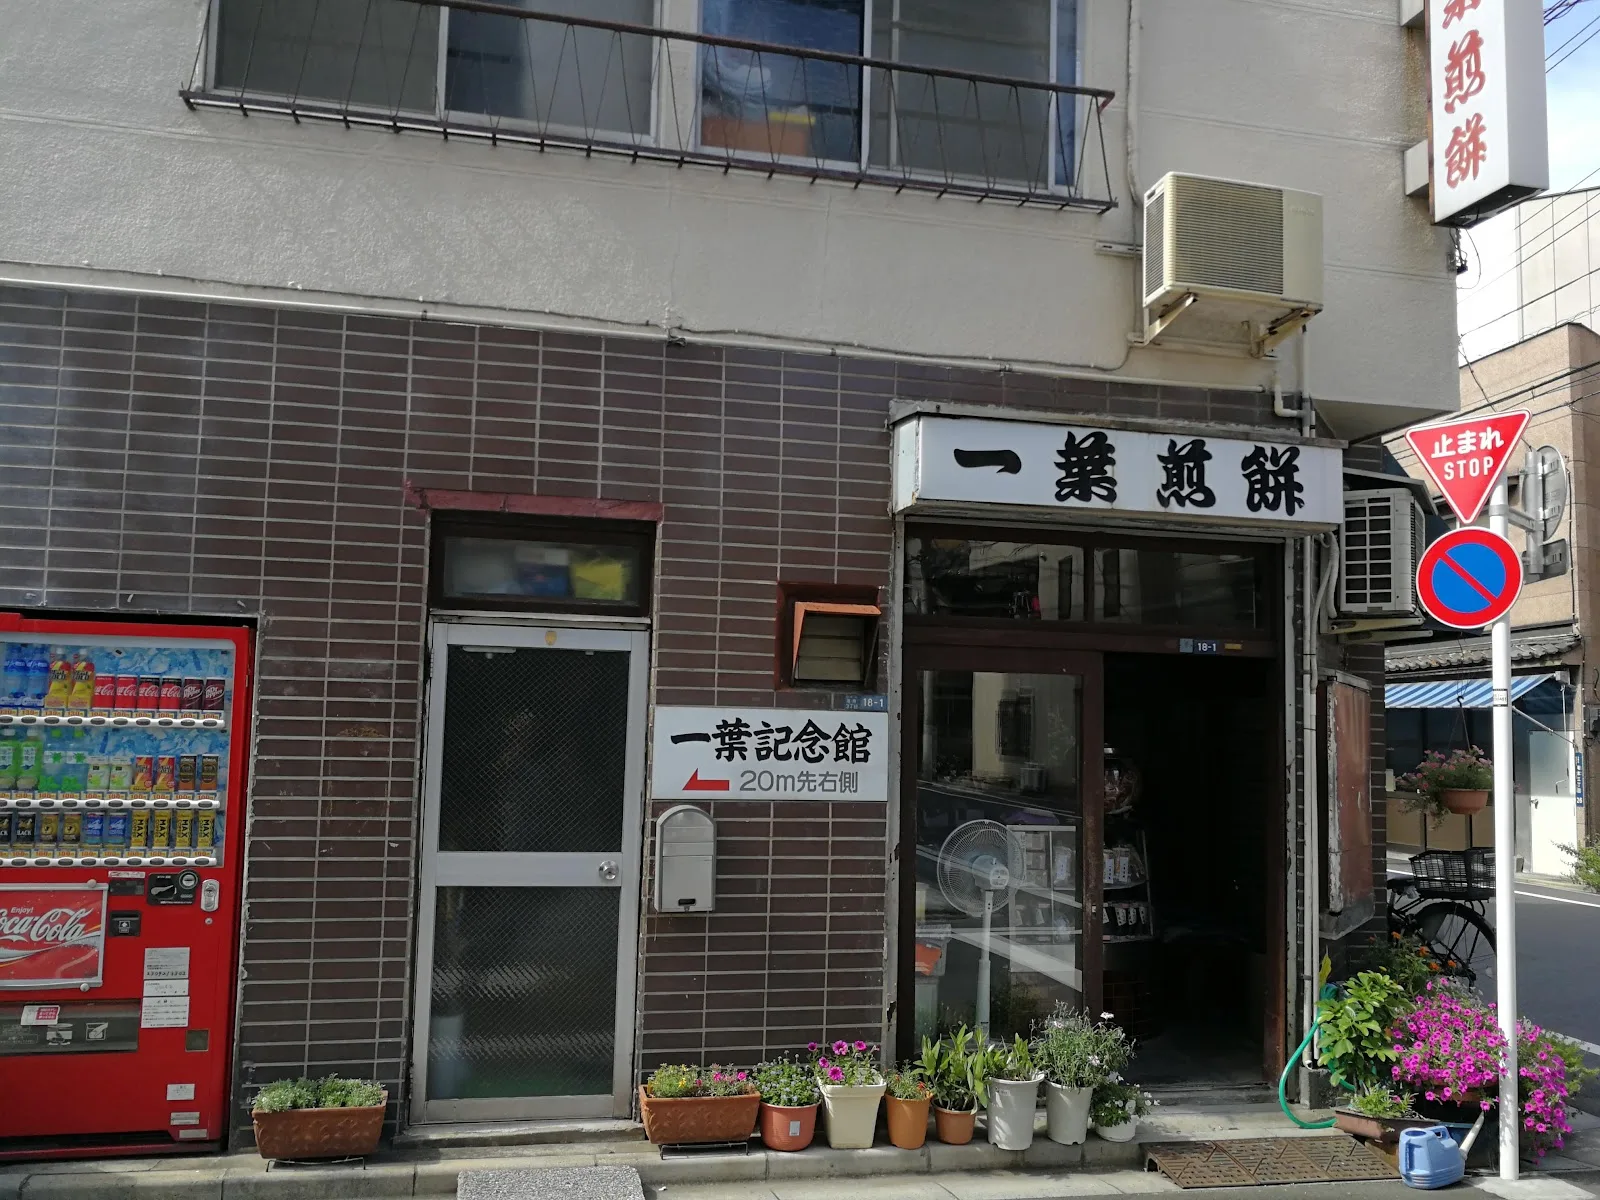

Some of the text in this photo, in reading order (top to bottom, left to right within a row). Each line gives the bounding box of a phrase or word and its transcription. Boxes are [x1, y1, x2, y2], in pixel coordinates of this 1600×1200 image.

[1431, 426, 1504, 458] 止まれ
[954, 431, 1305, 516] 一葉煎餅
[1444, 456, 1494, 480] STOP
[1198, 643, 1216, 652] 18-1
[863, 698, 884, 707] 18-1
[670, 717, 873, 764] 一葉記念館
[740, 770, 858, 793] 20m先右側
[136, 819, 144, 838] MAX
[158, 819, 166, 838] MAX
[181, 819, 189, 838] MAX
[202, 819, 210, 838] MAX
[11, 907, 33, 915] Enjoy!
